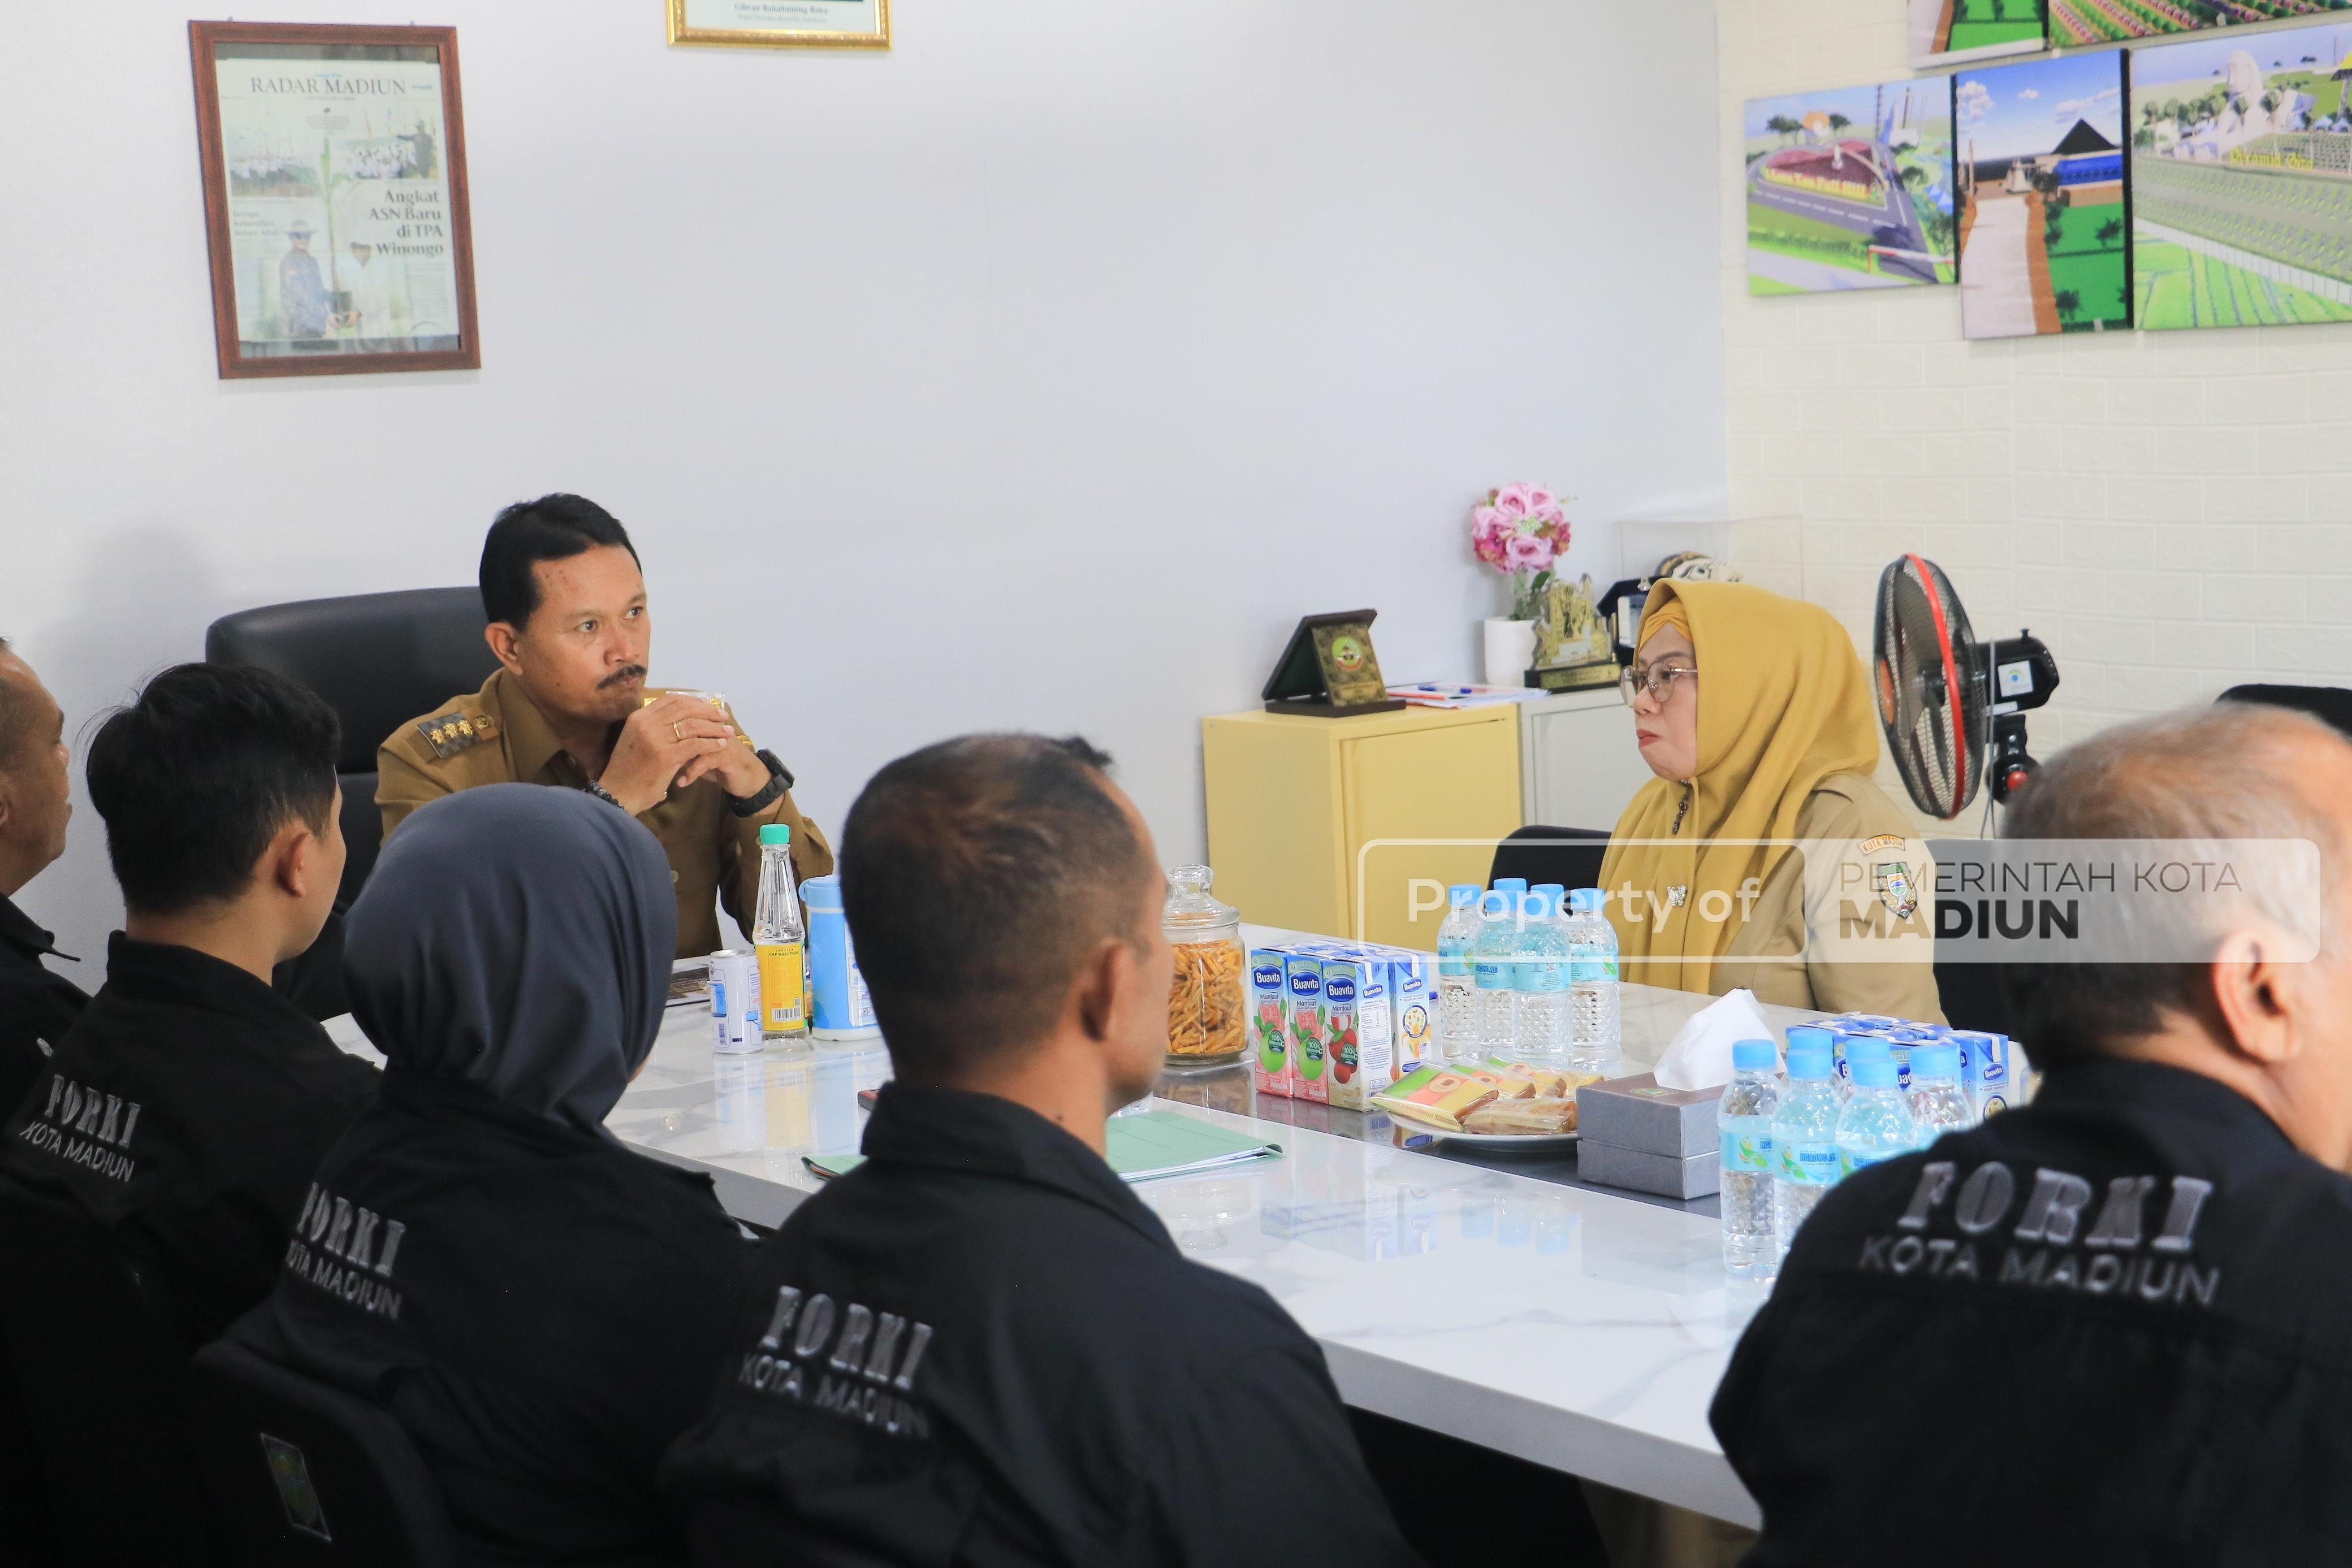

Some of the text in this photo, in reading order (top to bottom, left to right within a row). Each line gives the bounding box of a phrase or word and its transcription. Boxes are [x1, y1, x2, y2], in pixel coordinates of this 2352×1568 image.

[250, 77, 406, 96] RADAR MADIUN
[384, 190, 439, 205] Angkat
[369, 207, 441, 220] ASN Baru
[397, 224, 443, 237] di TPA
[377, 242, 444, 258] Winongo
[1862, 838, 1882, 853] KOTA
[1256, 972, 1281, 983] Buavita
[1293, 978, 1318, 989] Buavita
[1329, 985, 1353, 996] Buavita
[1364, 987, 1382, 997] Buavita
[1404, 981, 1421, 990] Buavita
[1296, 999, 1316, 1008] Manfaat
[1984, 1067, 2003, 1078] Buavita
[45, 1074, 141, 1149] FORKI
[20, 1121, 135, 1183] KOTA MADIUN
[1897, 1161, 2213, 1252] FORKI
[1858, 1234, 2221, 1305] KOTA MADIUN
[312, 1257, 402, 1320] MADIUN
[758, 1285, 933, 1391] FORKI
[738, 1353, 802, 1399] KOTA
